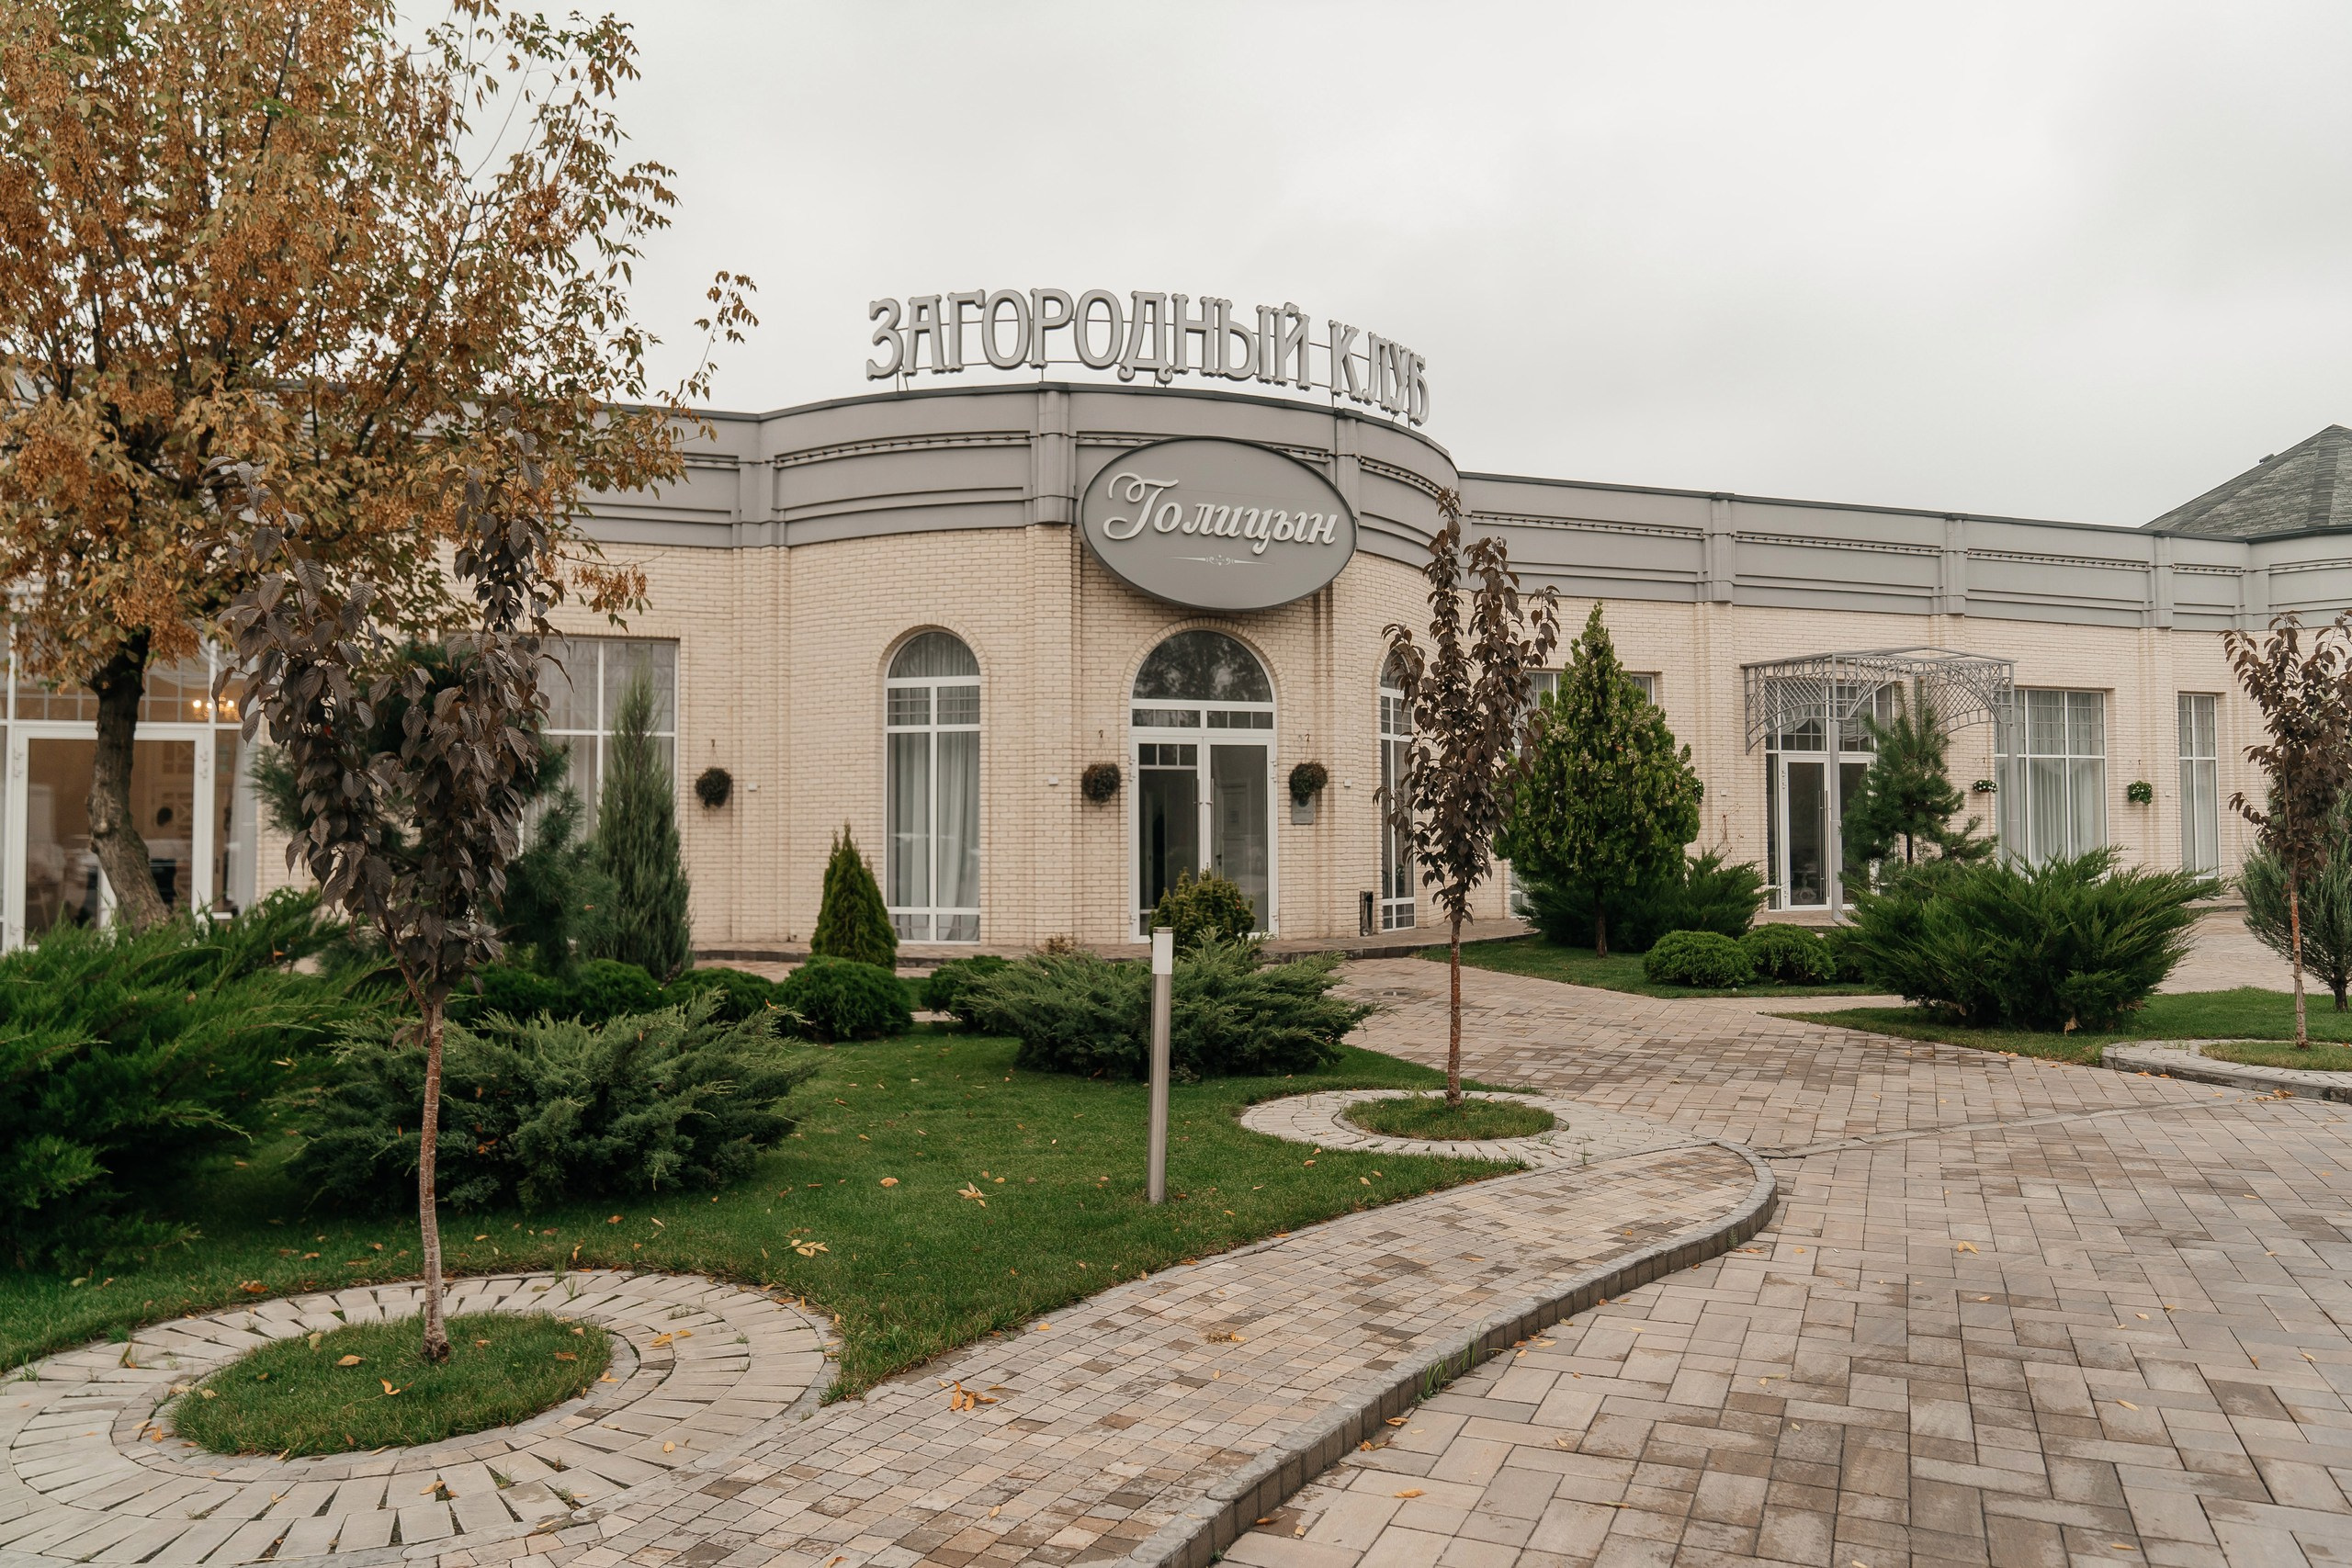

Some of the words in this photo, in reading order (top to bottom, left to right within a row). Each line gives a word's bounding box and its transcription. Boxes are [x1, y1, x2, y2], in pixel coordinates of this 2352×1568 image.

[866, 288, 1311, 390] ЗАГОРОДНЫЙ
[1329, 320, 1430, 425] КЛУБ
[1102, 472, 1338, 556] Голицын
